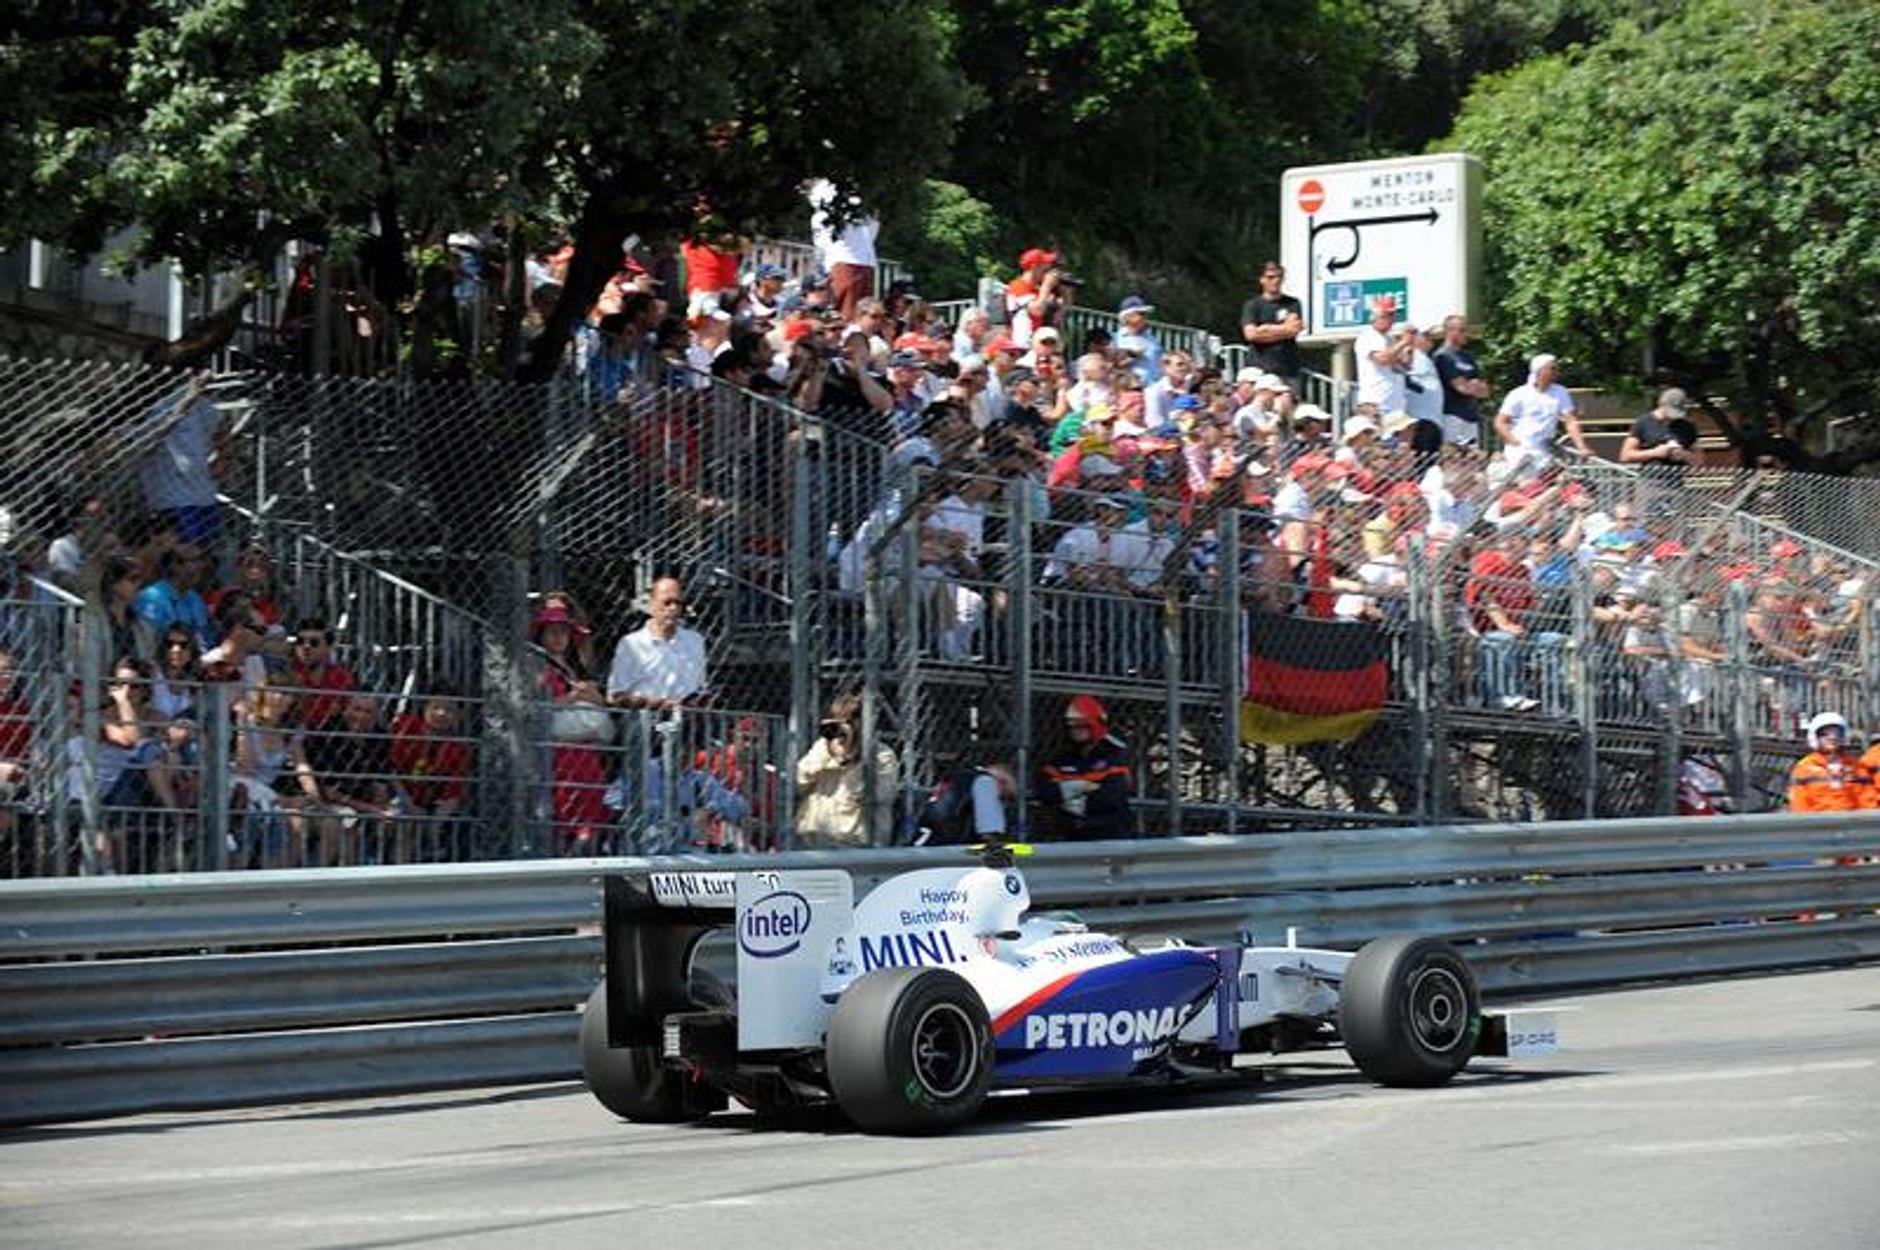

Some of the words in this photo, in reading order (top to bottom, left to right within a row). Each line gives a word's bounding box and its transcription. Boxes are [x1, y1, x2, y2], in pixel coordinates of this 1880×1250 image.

[655, 875, 700, 896] MINI
[921, 888, 968, 904] Happy
[747, 906, 799, 937] intel
